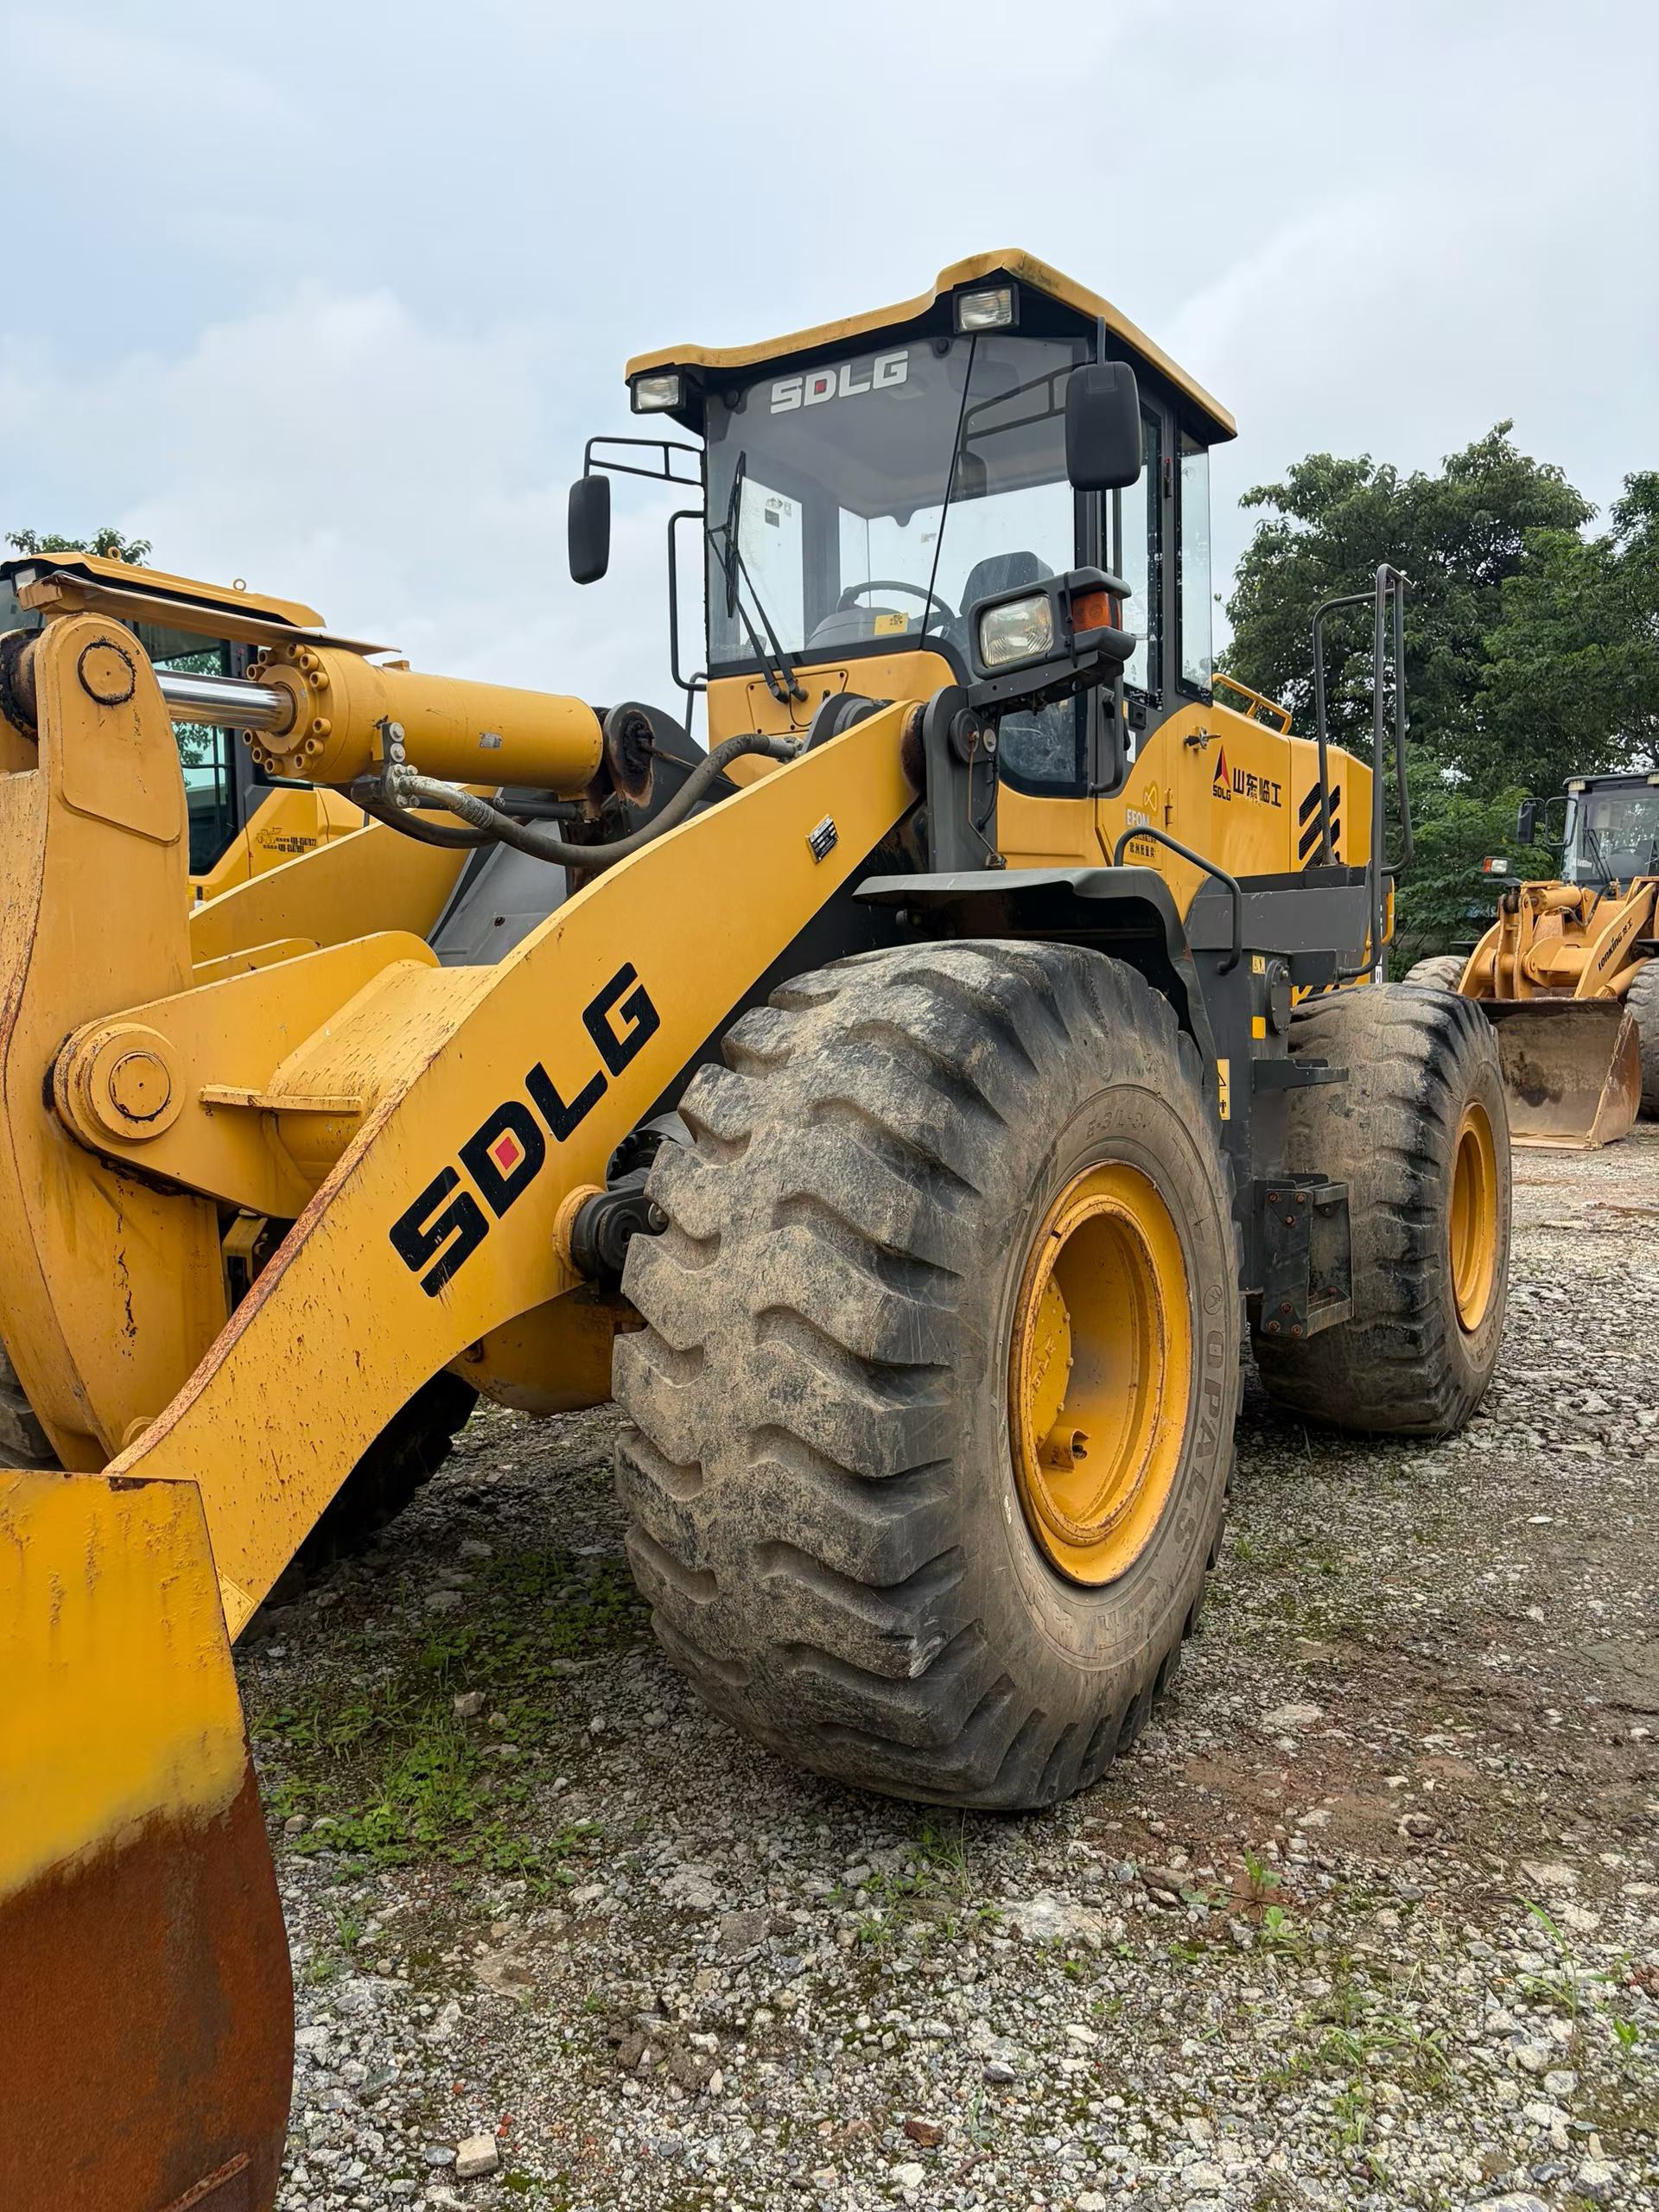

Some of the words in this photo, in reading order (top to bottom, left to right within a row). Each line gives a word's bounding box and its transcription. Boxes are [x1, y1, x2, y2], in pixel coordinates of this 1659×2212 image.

[771, 350, 908, 414] SDLG
[1212, 784, 1231, 802] SDLG
[1233, 767, 1281, 808] 山东临工
[389, 961, 661, 1298] SDLG
